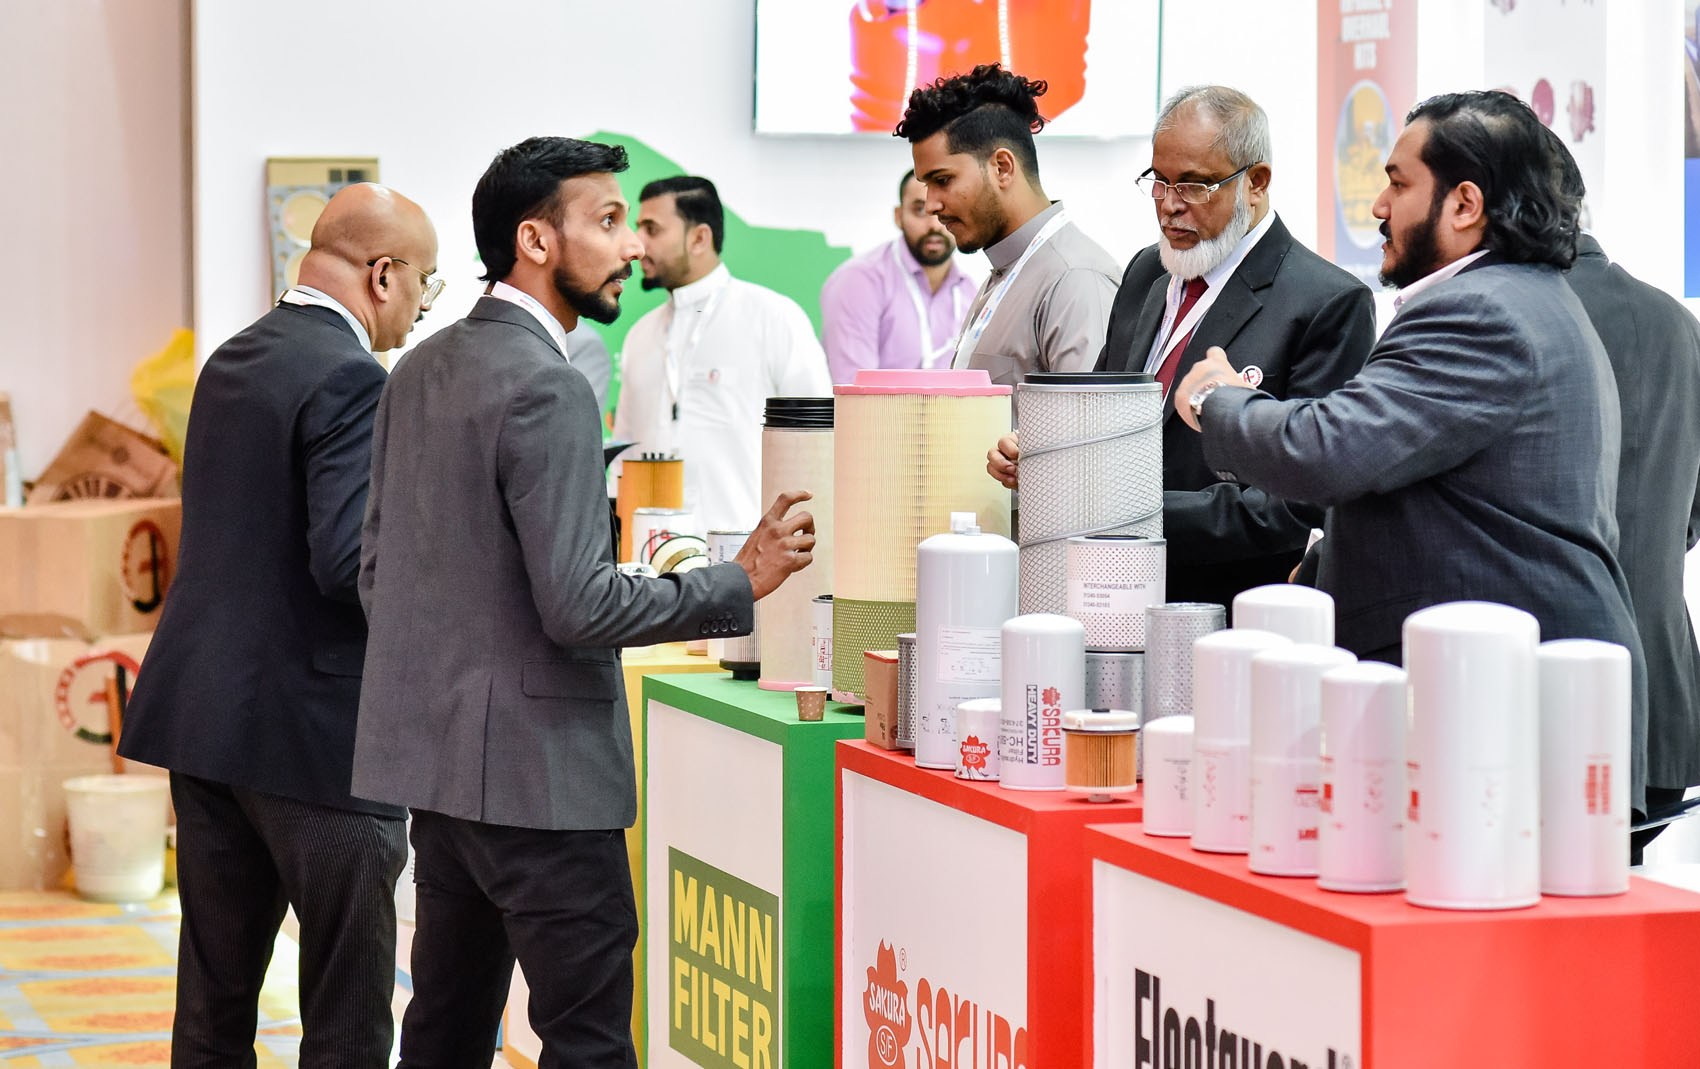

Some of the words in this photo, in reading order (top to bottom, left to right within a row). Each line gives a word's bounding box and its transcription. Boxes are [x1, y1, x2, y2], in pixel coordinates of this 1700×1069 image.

[1083, 582, 1133, 590] INTERCHANGEABLE
[1026, 685, 1038, 729] HEAVY
[1027, 729, 1038, 764] DUTY
[1042, 708, 1061, 766] SAKURA
[674, 869, 772, 993] MANN
[674, 956, 772, 1069] FILTER
[869, 981, 907, 1029] SAKURA
